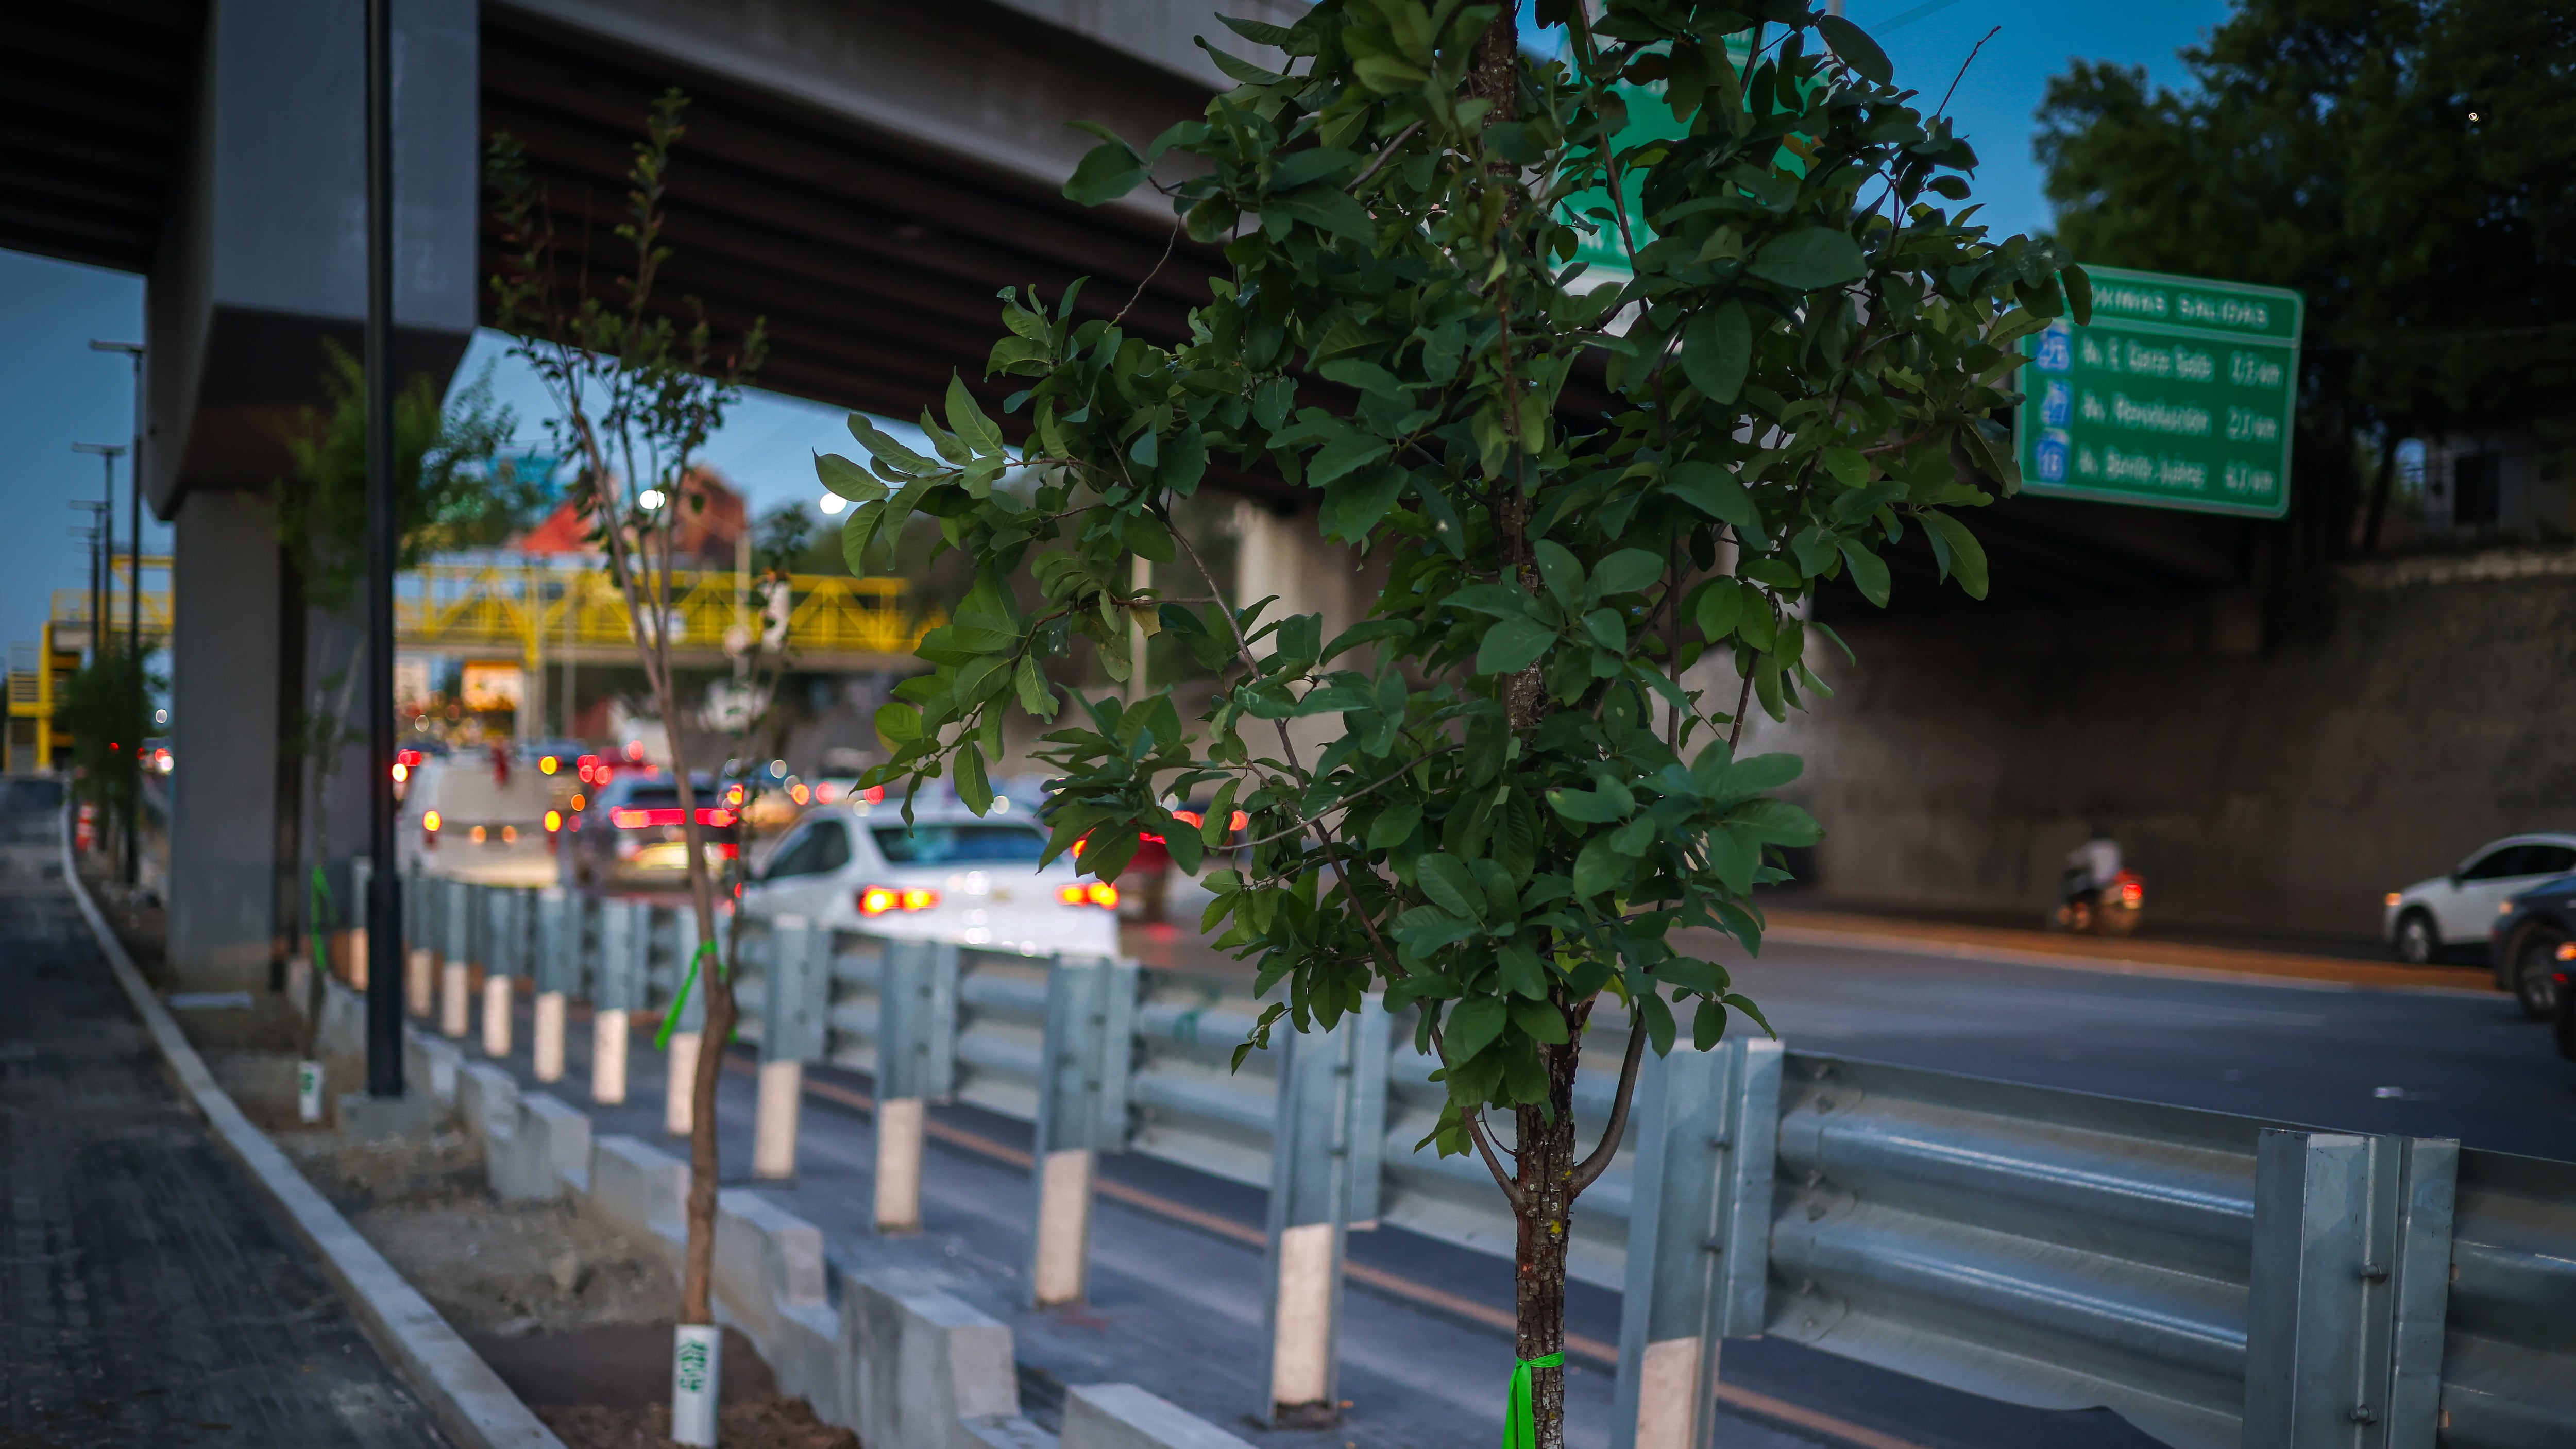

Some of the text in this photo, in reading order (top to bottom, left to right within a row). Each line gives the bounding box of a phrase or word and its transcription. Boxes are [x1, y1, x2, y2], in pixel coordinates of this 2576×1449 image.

[2177, 294, 2269, 328] SALIDAS
[2111, 394, 2212, 436] Revolución
[2103, 447, 2155, 483] Benito
[2153, 453, 2209, 489] Juárez
